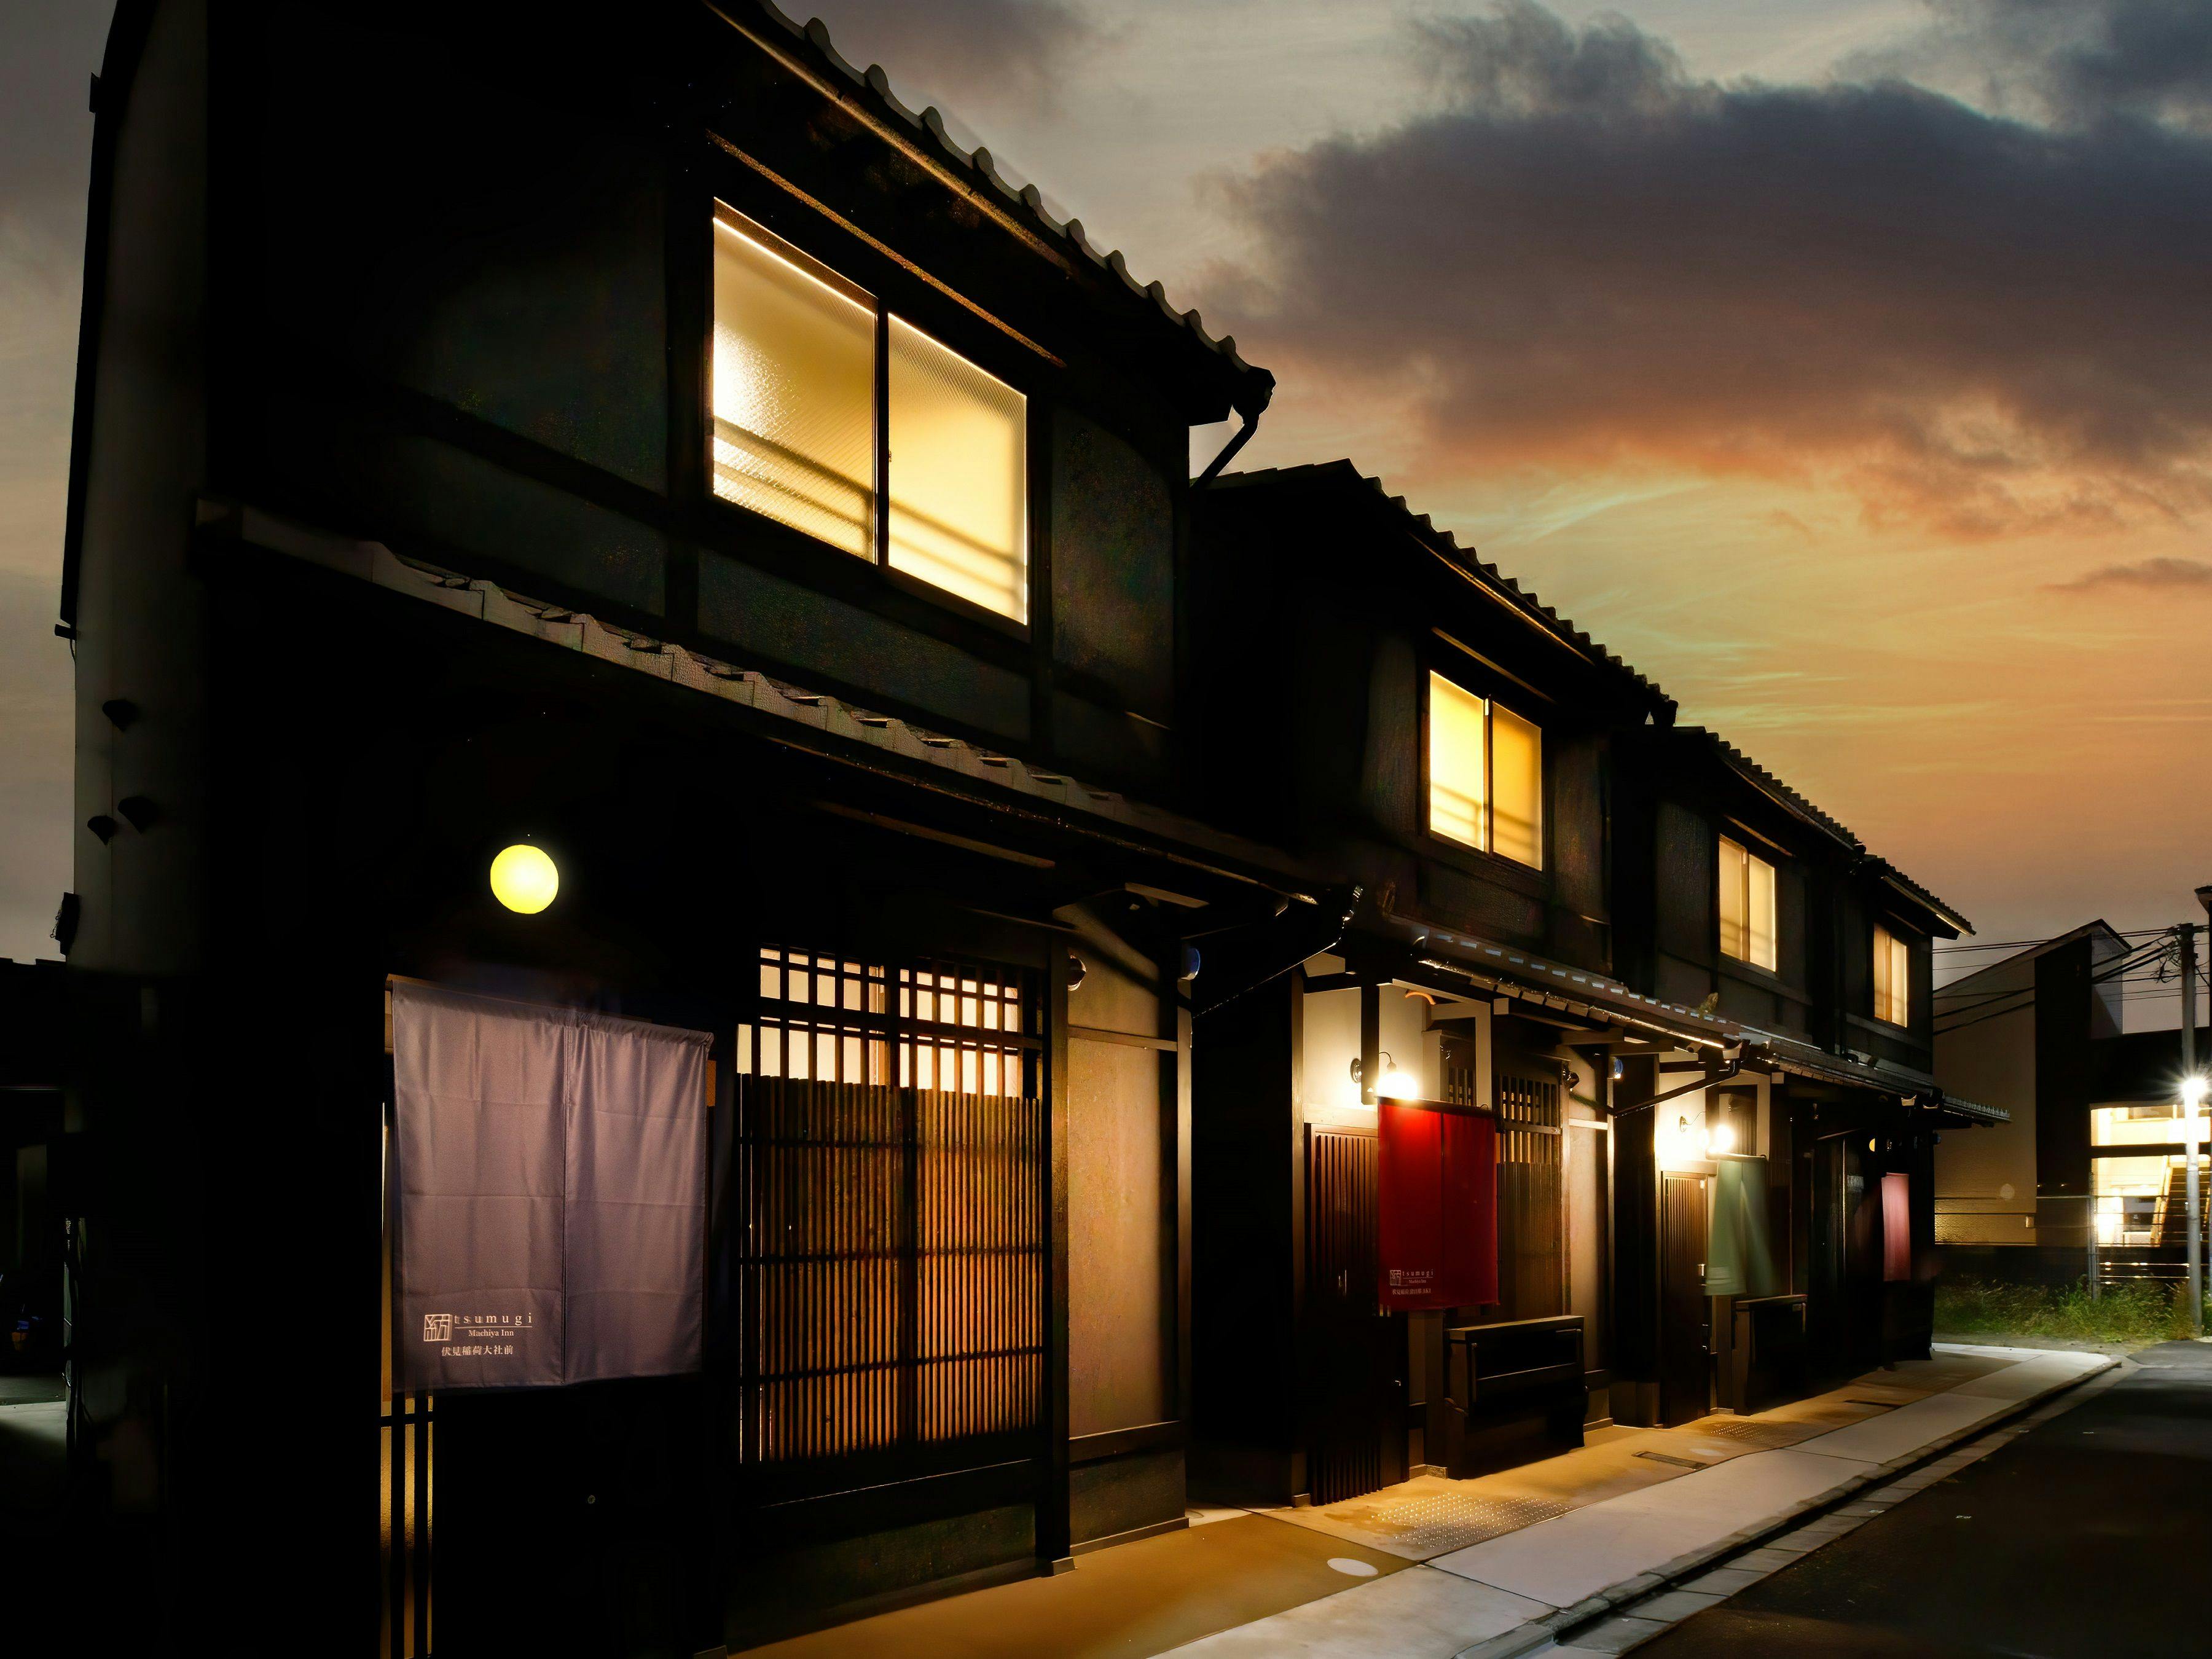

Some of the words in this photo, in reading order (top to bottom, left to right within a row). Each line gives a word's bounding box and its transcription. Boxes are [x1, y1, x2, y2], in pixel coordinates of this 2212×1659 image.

[454, 1312, 532, 1326] tsumugi
[468, 1329, 500, 1338] Machiya
[441, 1344, 514, 1357] 伏見稲荷大社前
